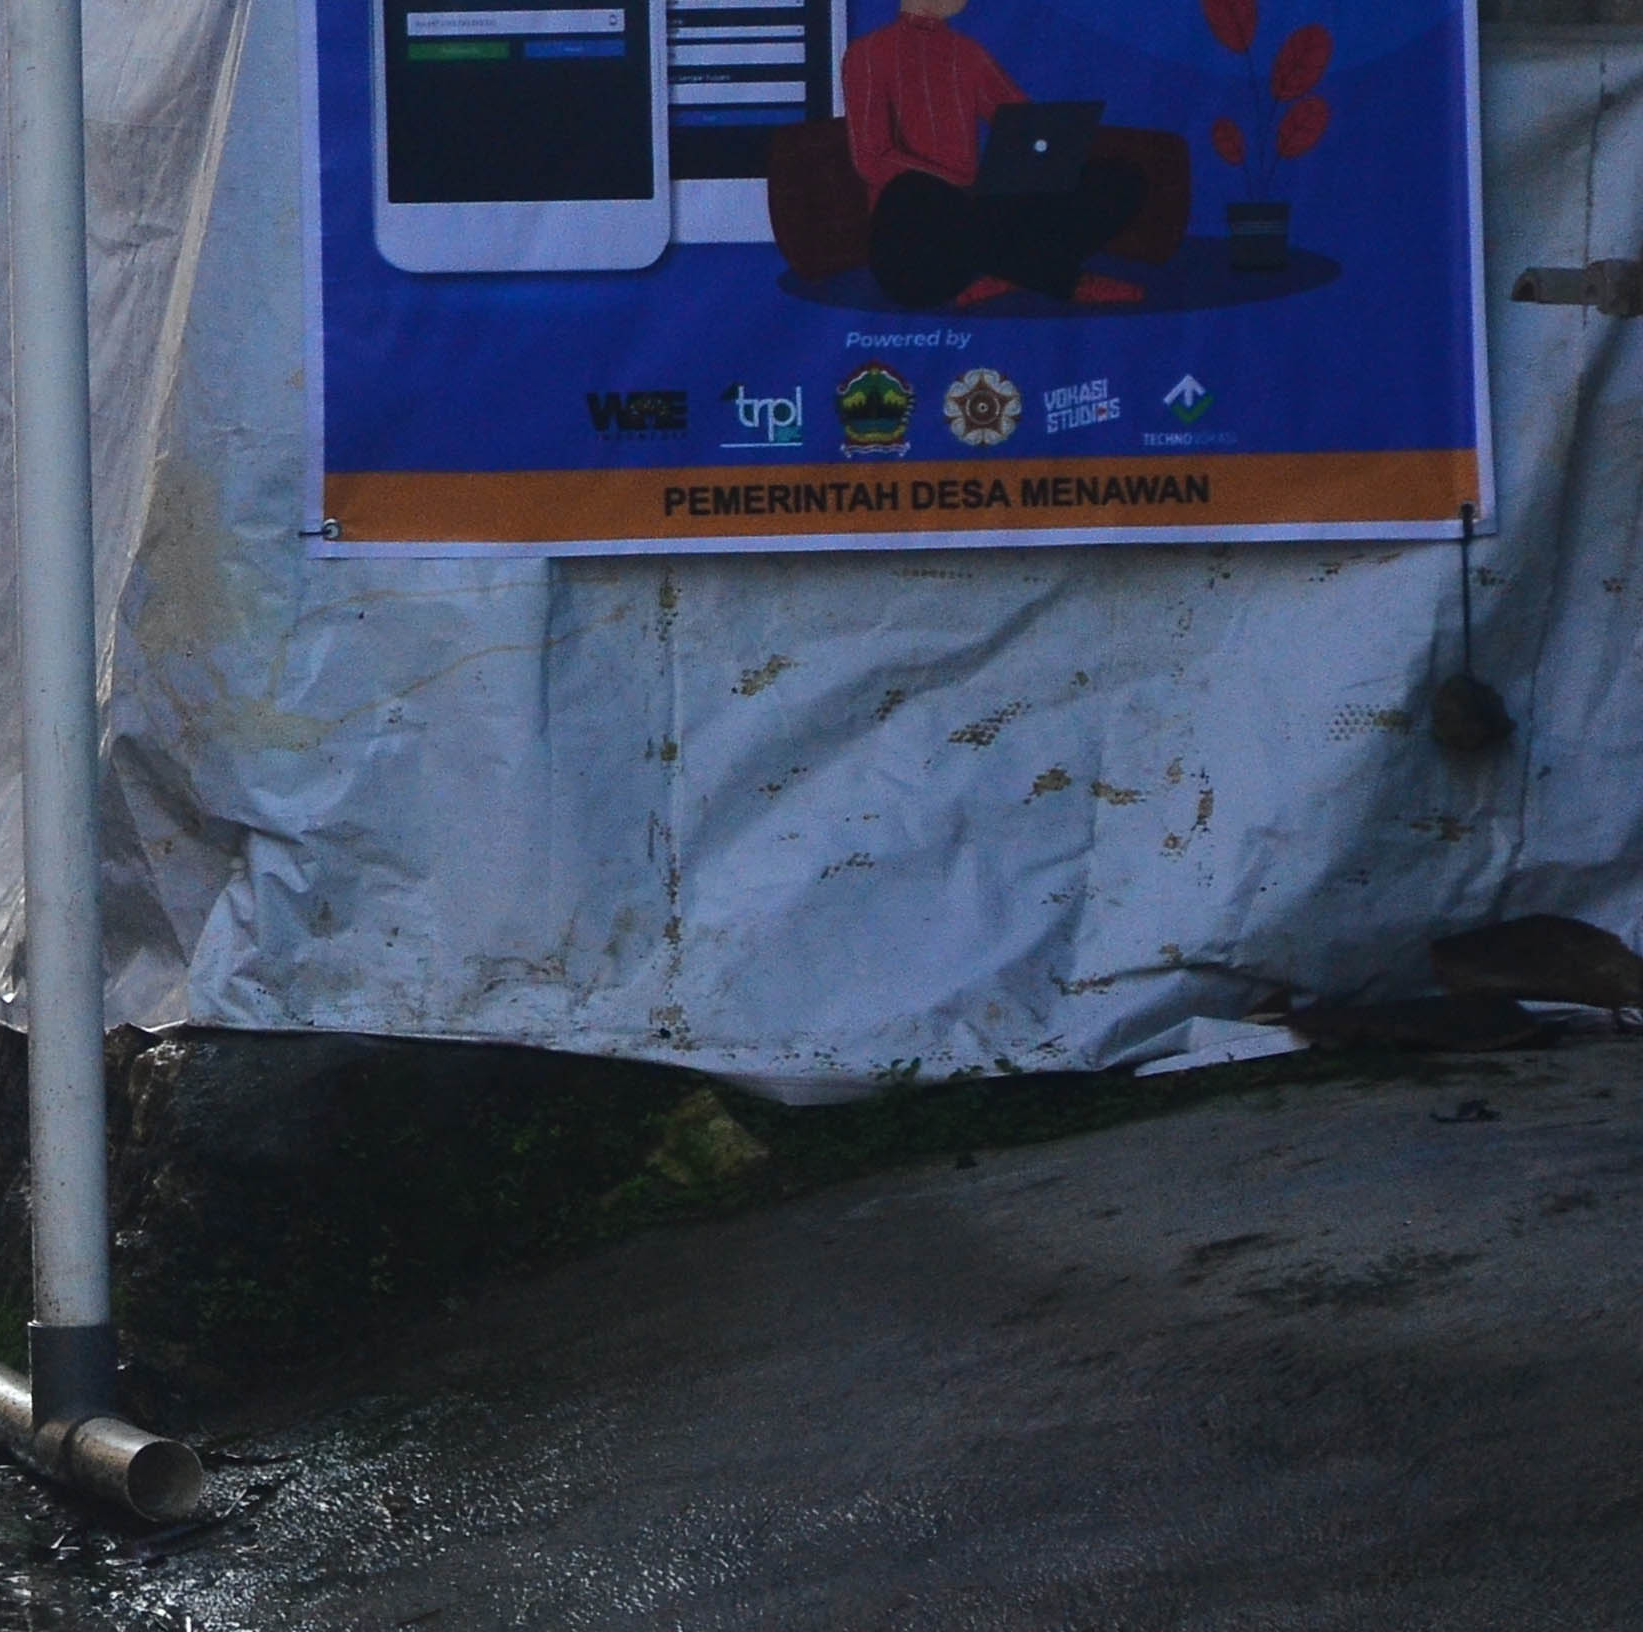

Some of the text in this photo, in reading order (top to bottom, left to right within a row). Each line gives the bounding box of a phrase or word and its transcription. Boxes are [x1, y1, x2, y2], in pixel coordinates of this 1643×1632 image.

[846, 329, 972, 351] Powered by
[1044, 378, 1108, 411] VOKASI
[664, 474, 1210, 516] PEMERINTAH DESA MENAWAN
